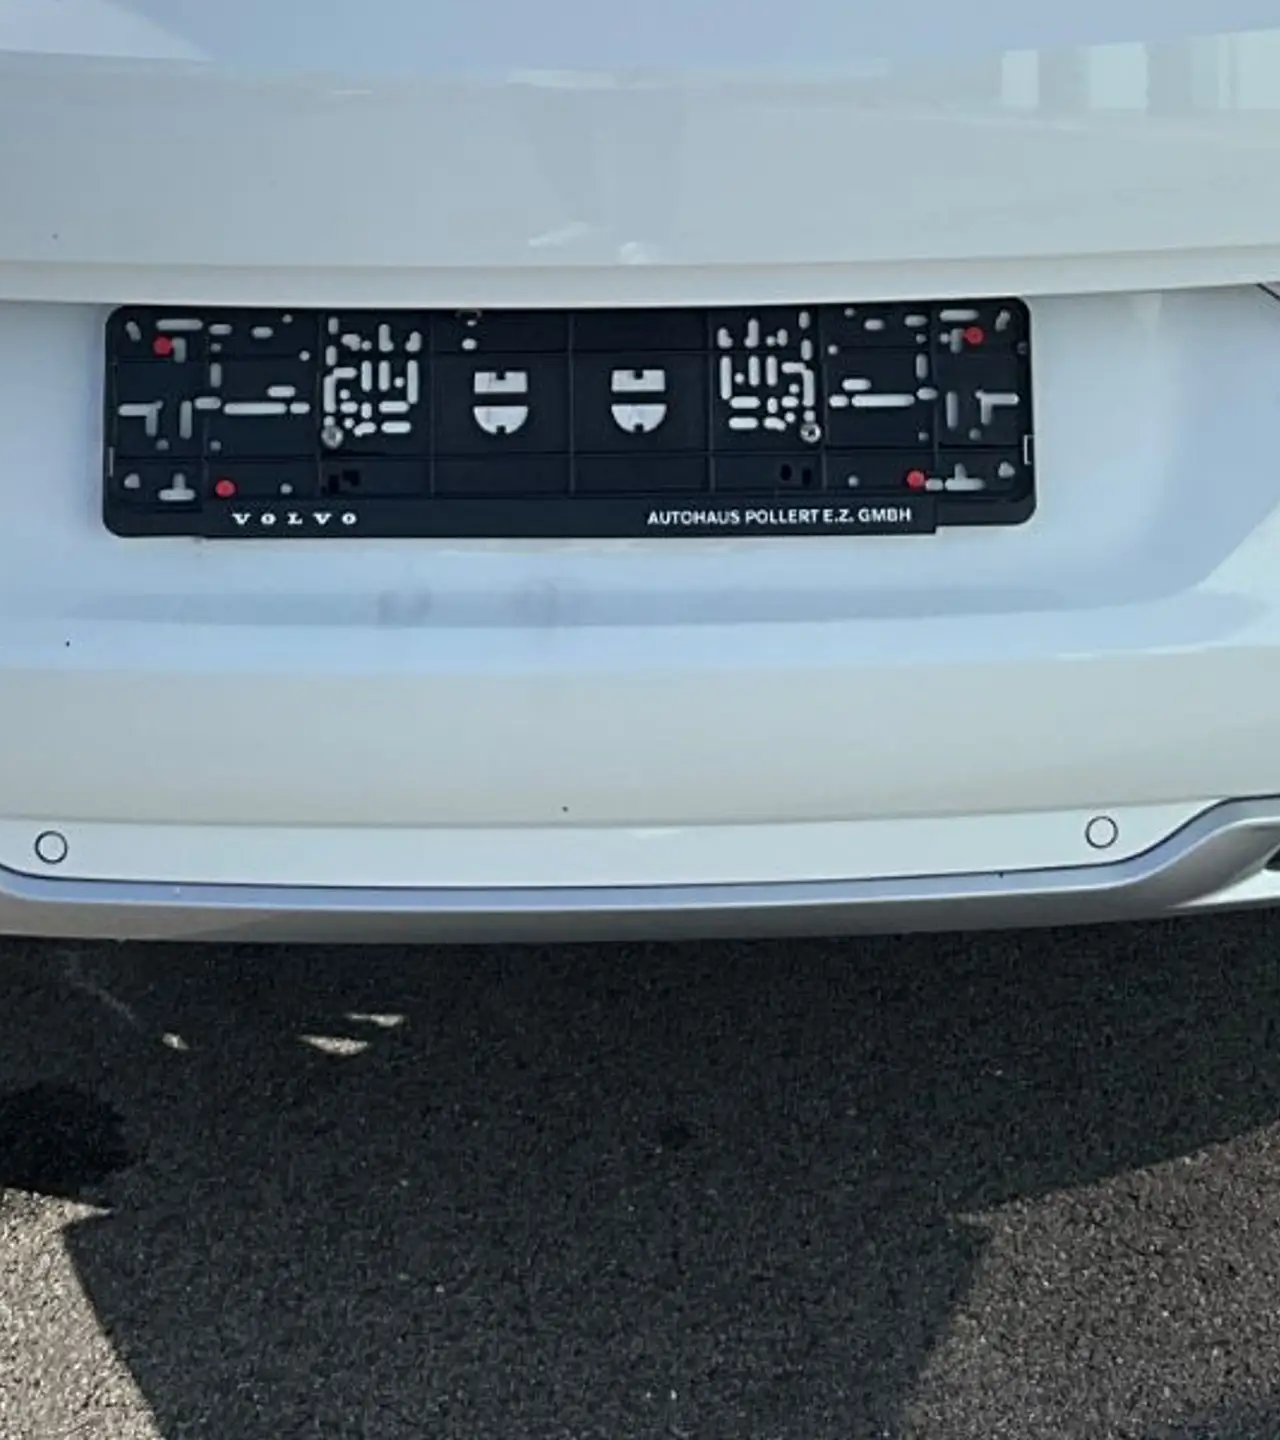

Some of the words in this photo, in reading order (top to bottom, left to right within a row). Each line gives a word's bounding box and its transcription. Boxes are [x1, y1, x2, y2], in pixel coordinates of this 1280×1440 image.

[232, 512, 357, 526] VOLVO
[646, 510, 740, 526] AUTOHAUS
[745, 509, 820, 525] POLLERT
[823, 508, 855, 523] E.Z.
[858, 507, 912, 523] GMBH
